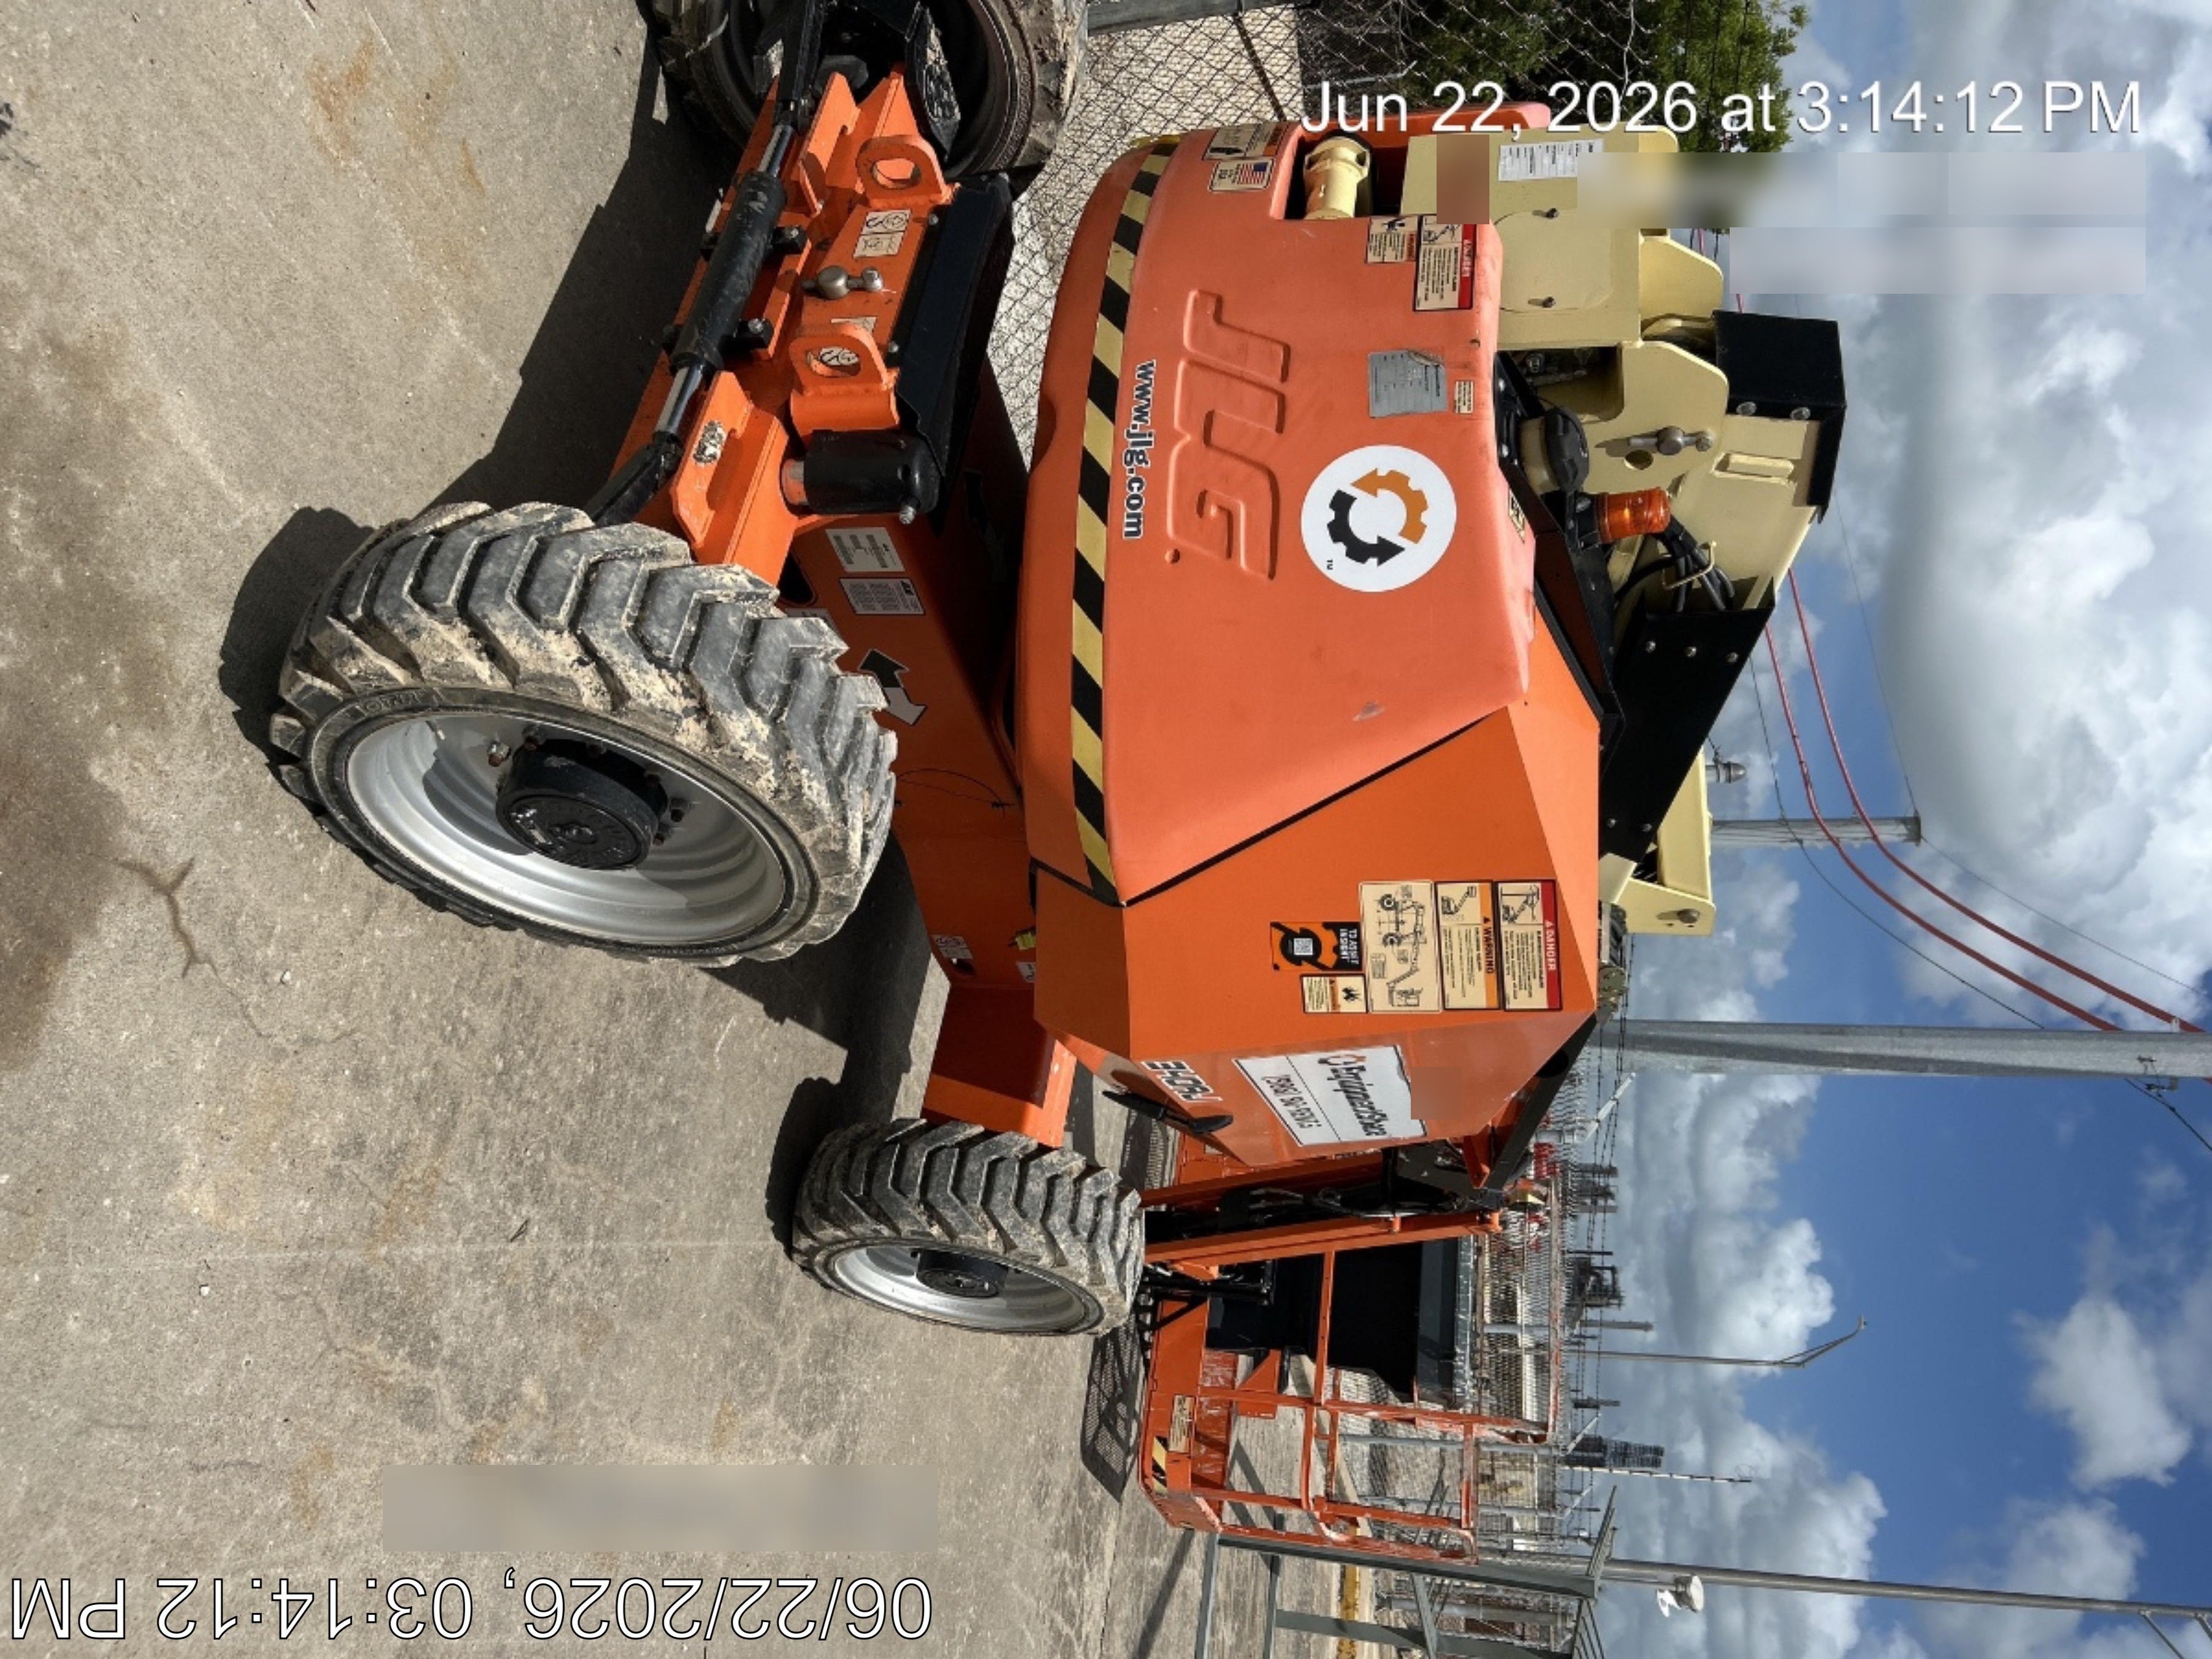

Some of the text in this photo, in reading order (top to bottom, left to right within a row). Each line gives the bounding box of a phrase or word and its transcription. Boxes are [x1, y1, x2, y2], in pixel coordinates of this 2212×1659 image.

[1123, 358, 1158, 539] www.jlg.com
[1166, 289, 1292, 581] JLG
[1339, 928, 1349, 963] INSIGHT
[1483, 927, 1495, 975] WARNING
[1545, 928, 1556, 971] DANGER
[1327, 1065, 1390, 1136] EquipmentShare
